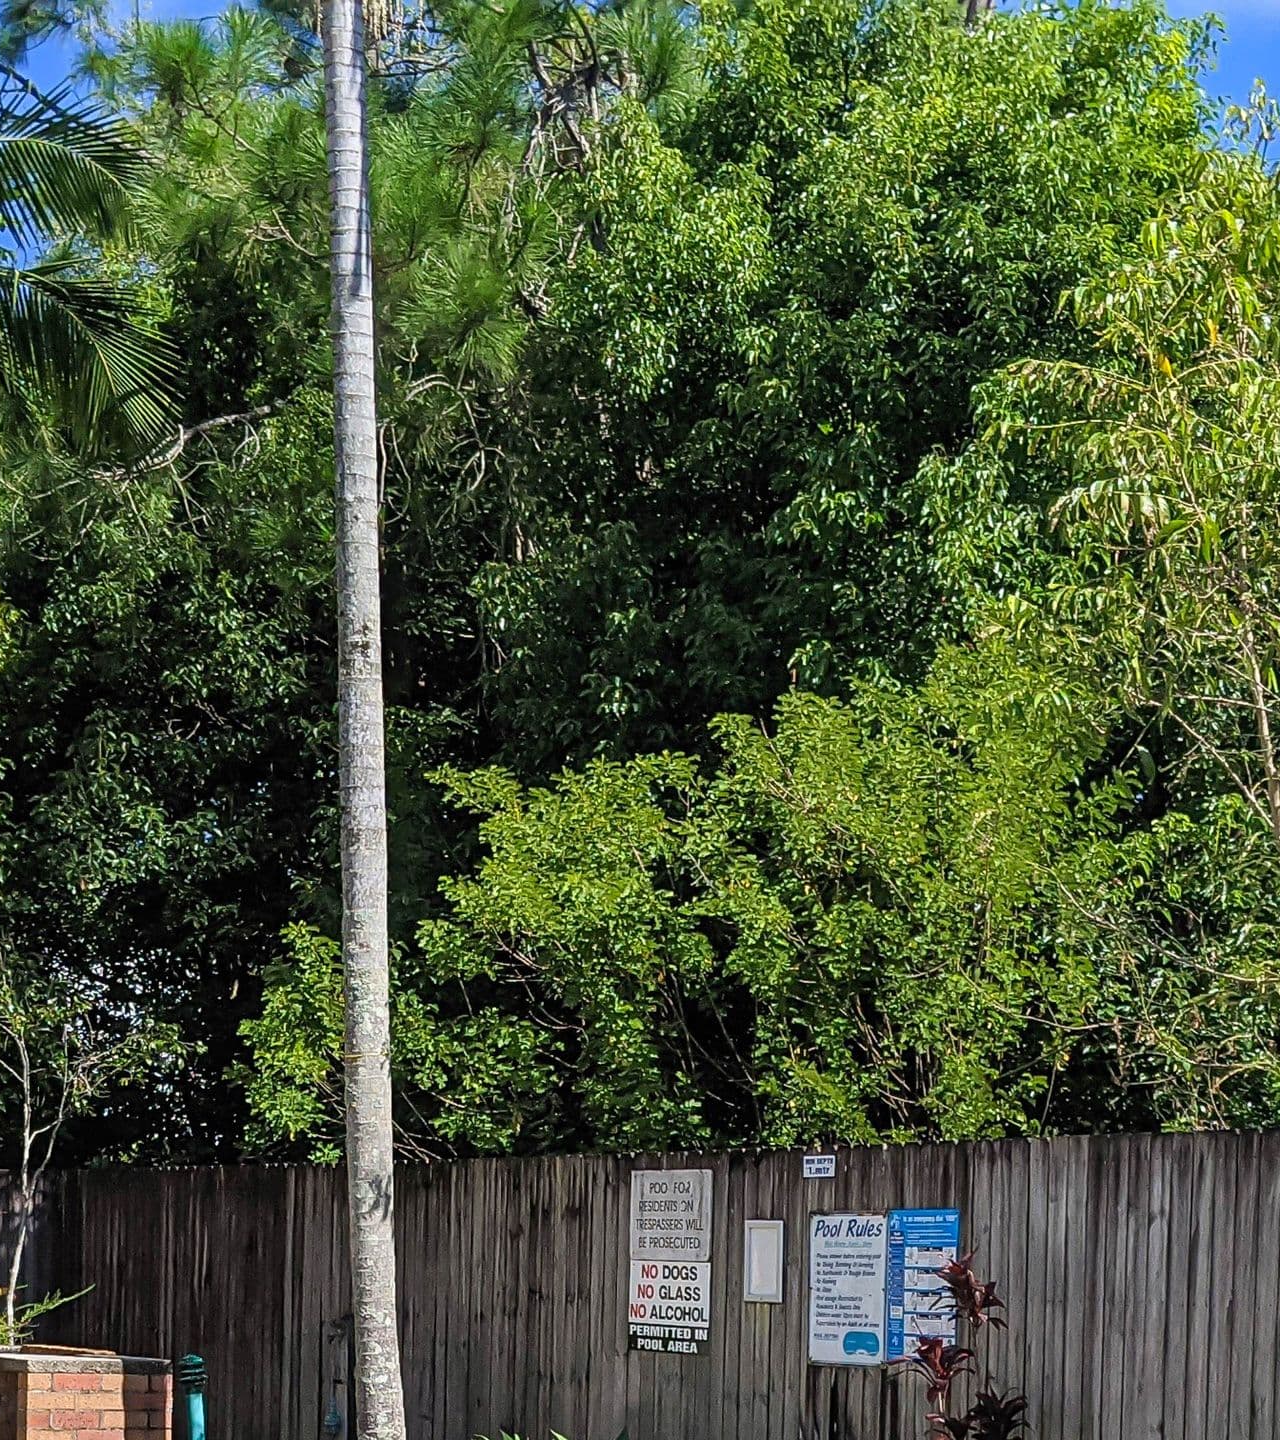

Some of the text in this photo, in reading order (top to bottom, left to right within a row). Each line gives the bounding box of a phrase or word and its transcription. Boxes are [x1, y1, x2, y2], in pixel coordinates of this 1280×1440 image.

[649, 1182, 669, 1194] POO
[638, 1200, 678, 1213] RESIDENTS
[635, 1218, 704, 1231] TRESPASSERS WILL
[814, 1218, 844, 1238] Pool
[845, 1218, 884, 1238] Rules
[638, 1236, 701, 1249] BE PROSECUTED
[641, 1264, 698, 1281] NO DOGS
[637, 1283, 701, 1302] NO GLASS
[630, 1303, 708, 1323] NO ALCOHOL
[629, 1324, 708, 1341] PERMITTED IN
[637, 1337, 698, 1354] POOL AREA
